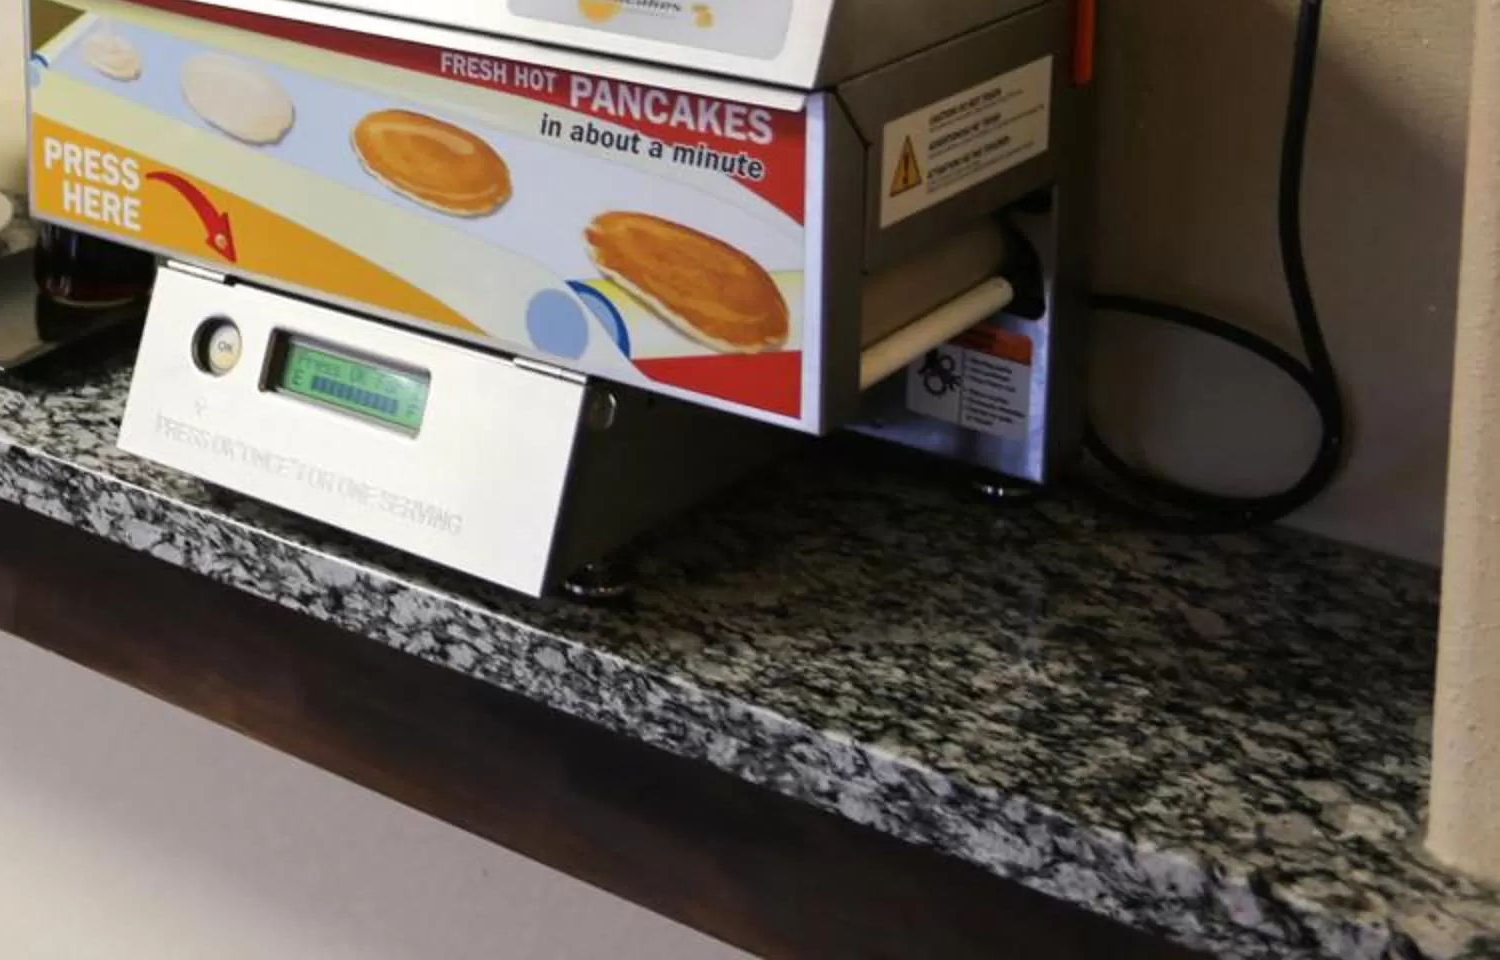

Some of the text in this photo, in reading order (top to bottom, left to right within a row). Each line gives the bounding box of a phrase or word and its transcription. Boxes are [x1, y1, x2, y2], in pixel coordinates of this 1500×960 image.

[440, 52, 774, 145] FRESH HOT PANCAKES
[43, 136, 141, 192] PRESS
[540, 113, 764, 179] in about a minute
[62, 179, 142, 231] HERE
